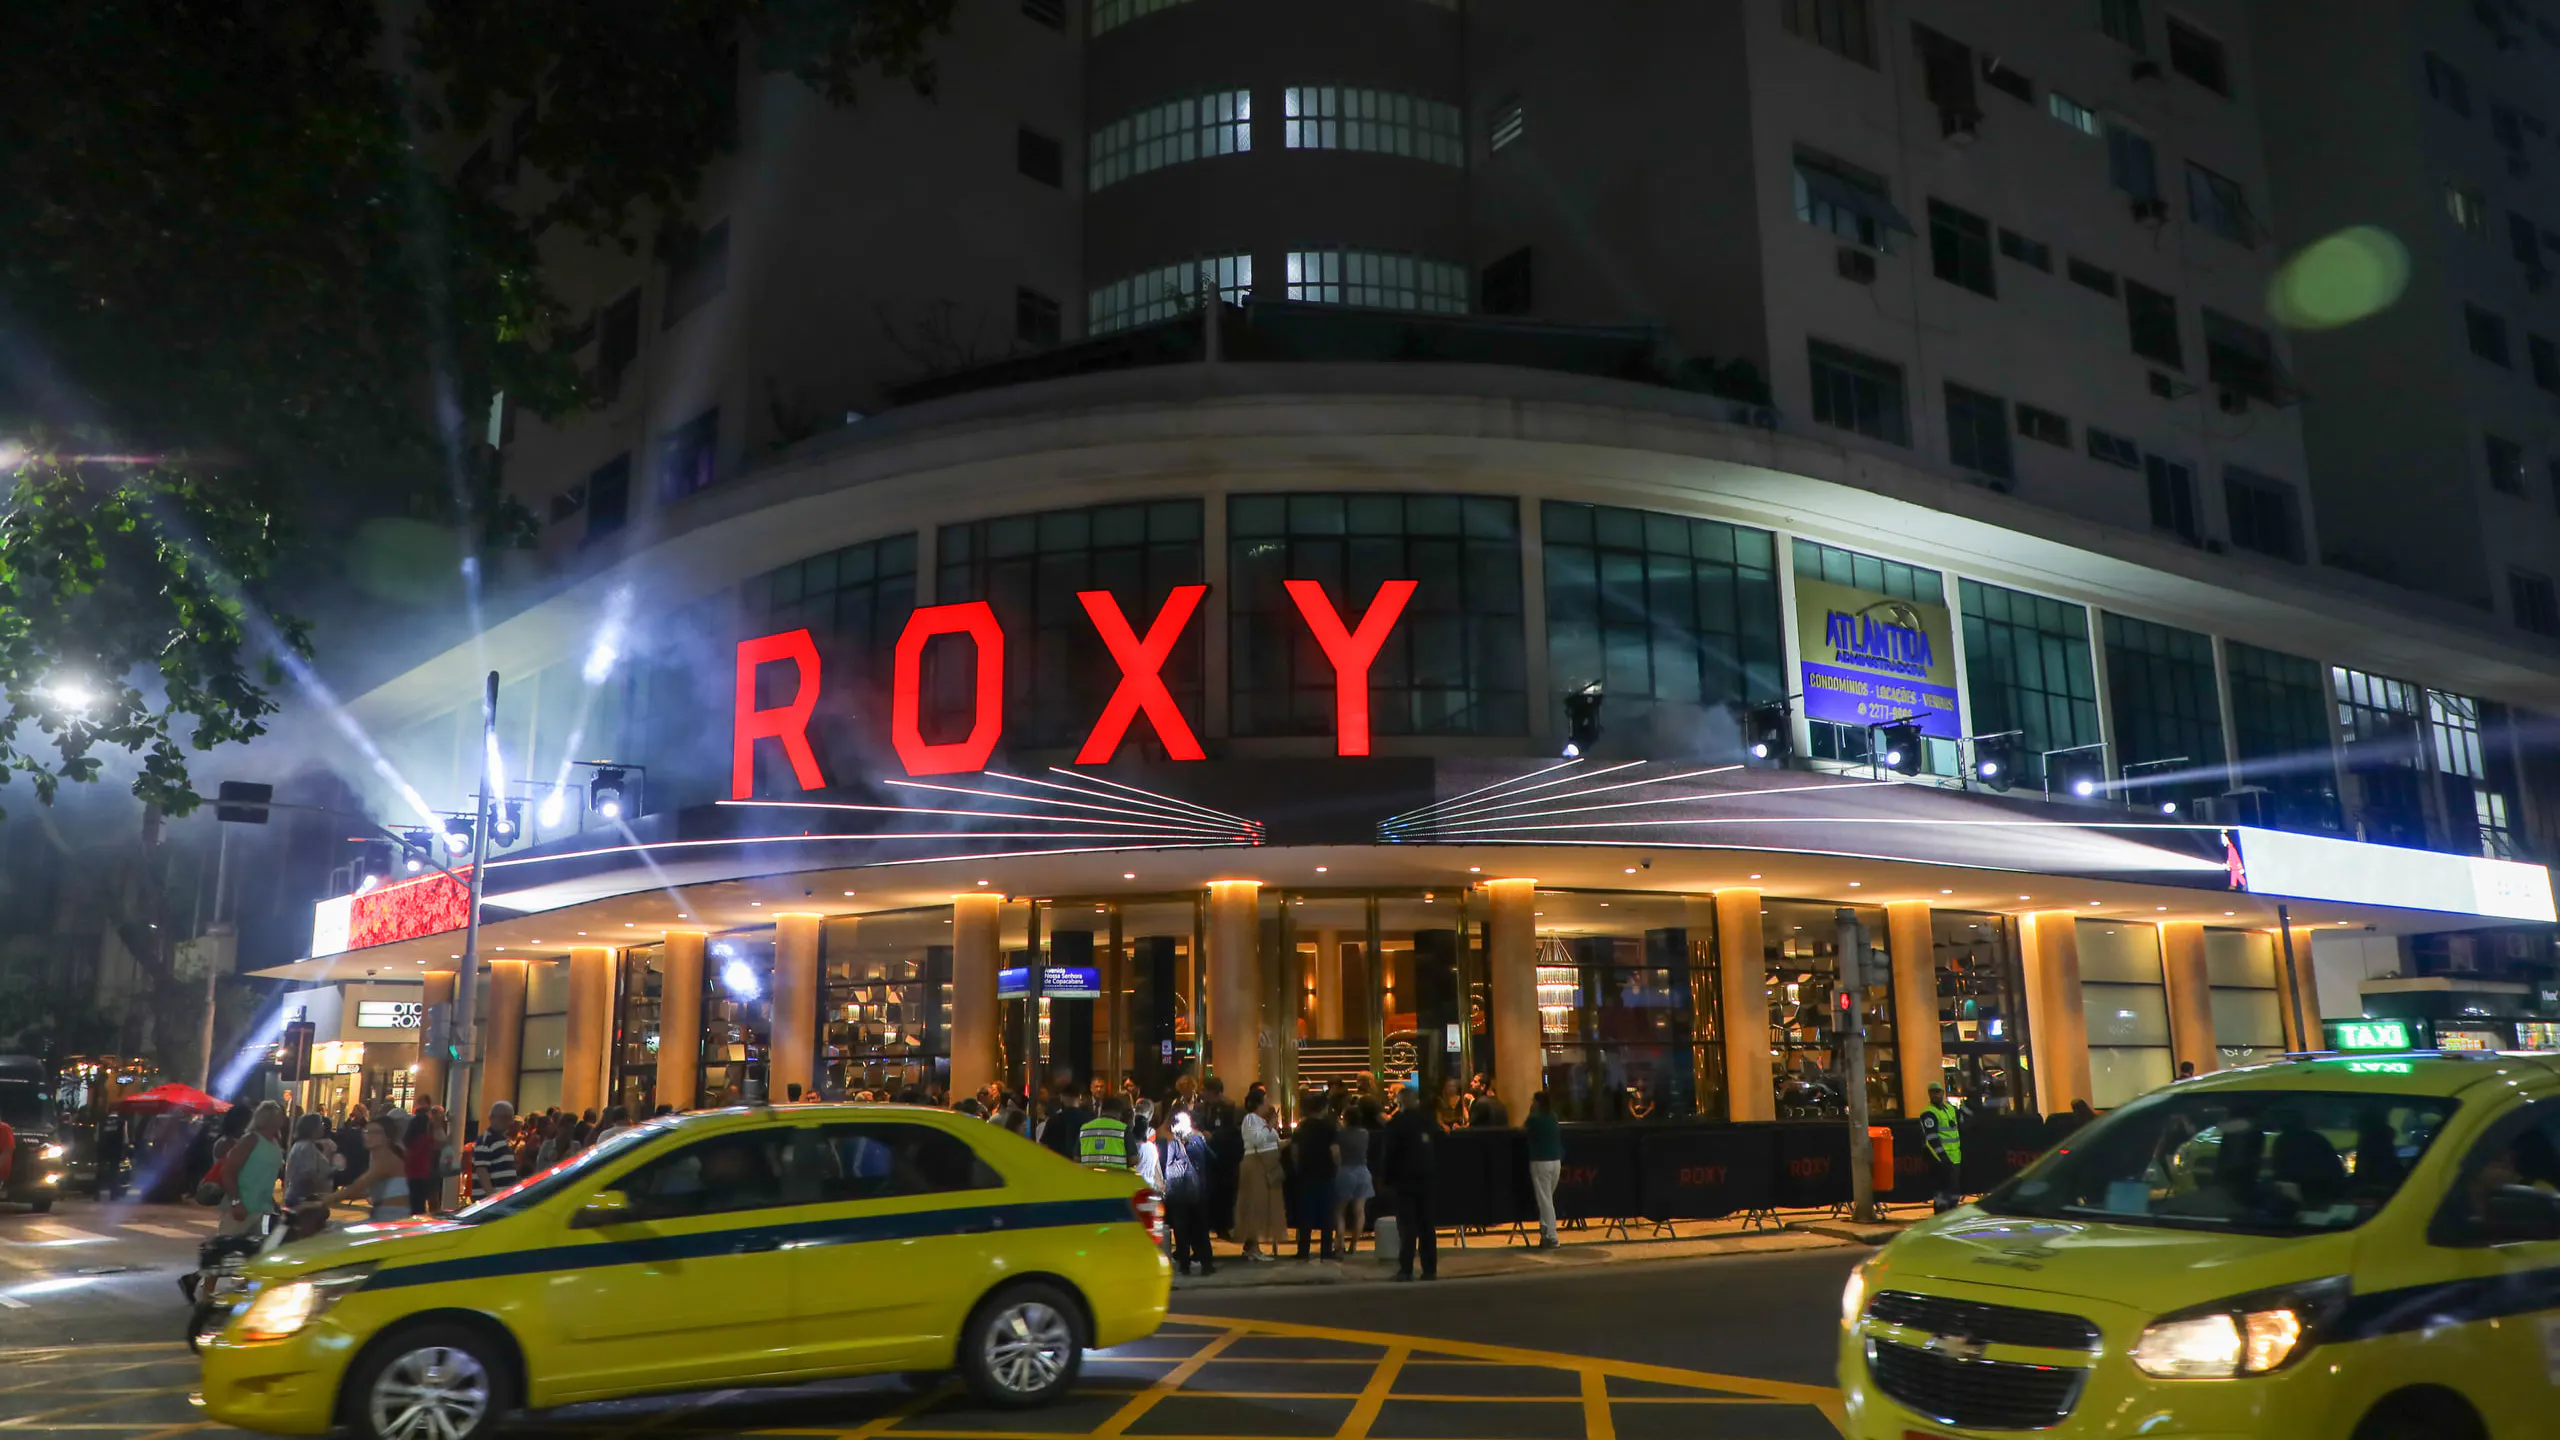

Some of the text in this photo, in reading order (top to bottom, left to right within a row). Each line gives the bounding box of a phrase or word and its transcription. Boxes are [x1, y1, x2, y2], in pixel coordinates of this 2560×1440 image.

[732, 580, 1419, 800] ROXY
[1809, 672, 1868, 697] CONDOMÍNIOS
[1876, 685, 1917, 705] LOCAÇÕES
[2339, 1025, 2403, 1047] TAXI
[1680, 1166, 1728, 1185] ROXY
[1790, 1156, 1831, 1177] ROXY
